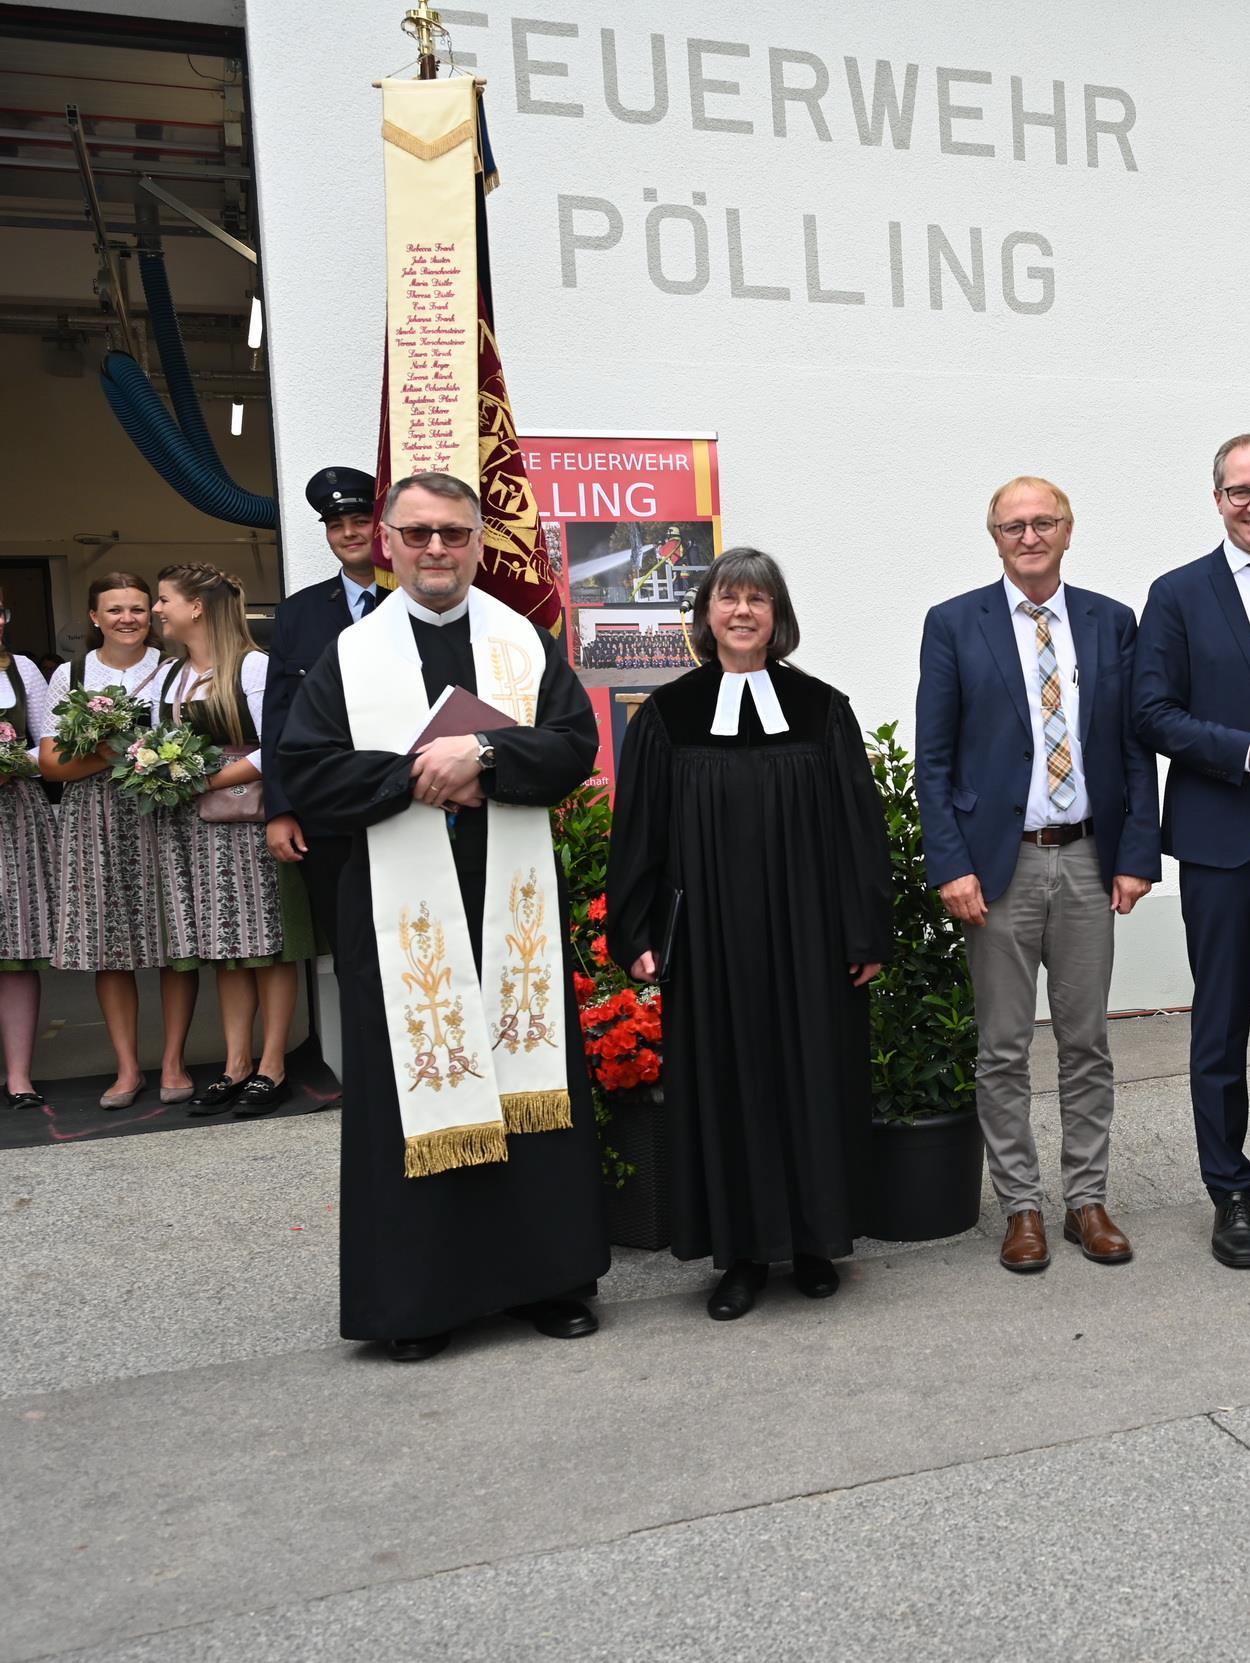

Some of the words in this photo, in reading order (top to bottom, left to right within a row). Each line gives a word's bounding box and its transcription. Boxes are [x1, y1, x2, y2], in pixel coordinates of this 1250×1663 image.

[406, 243, 432, 252] Rebecca
[435, 242, 455, 252] Frank
[557, 187, 1055, 315] PÖLLING
[411, 255, 426, 265] Julia
[401, 267, 416, 277] Julia
[409, 278, 428, 287] Maria
[406, 290, 431, 299] Theresa
[406, 315, 432, 325] Johanna
[435, 314, 455, 322] Frank
[409, 419, 424, 429] Julia
[551, 453, 689, 471] FEUERWEHR
[538, 482, 657, 517] LING
